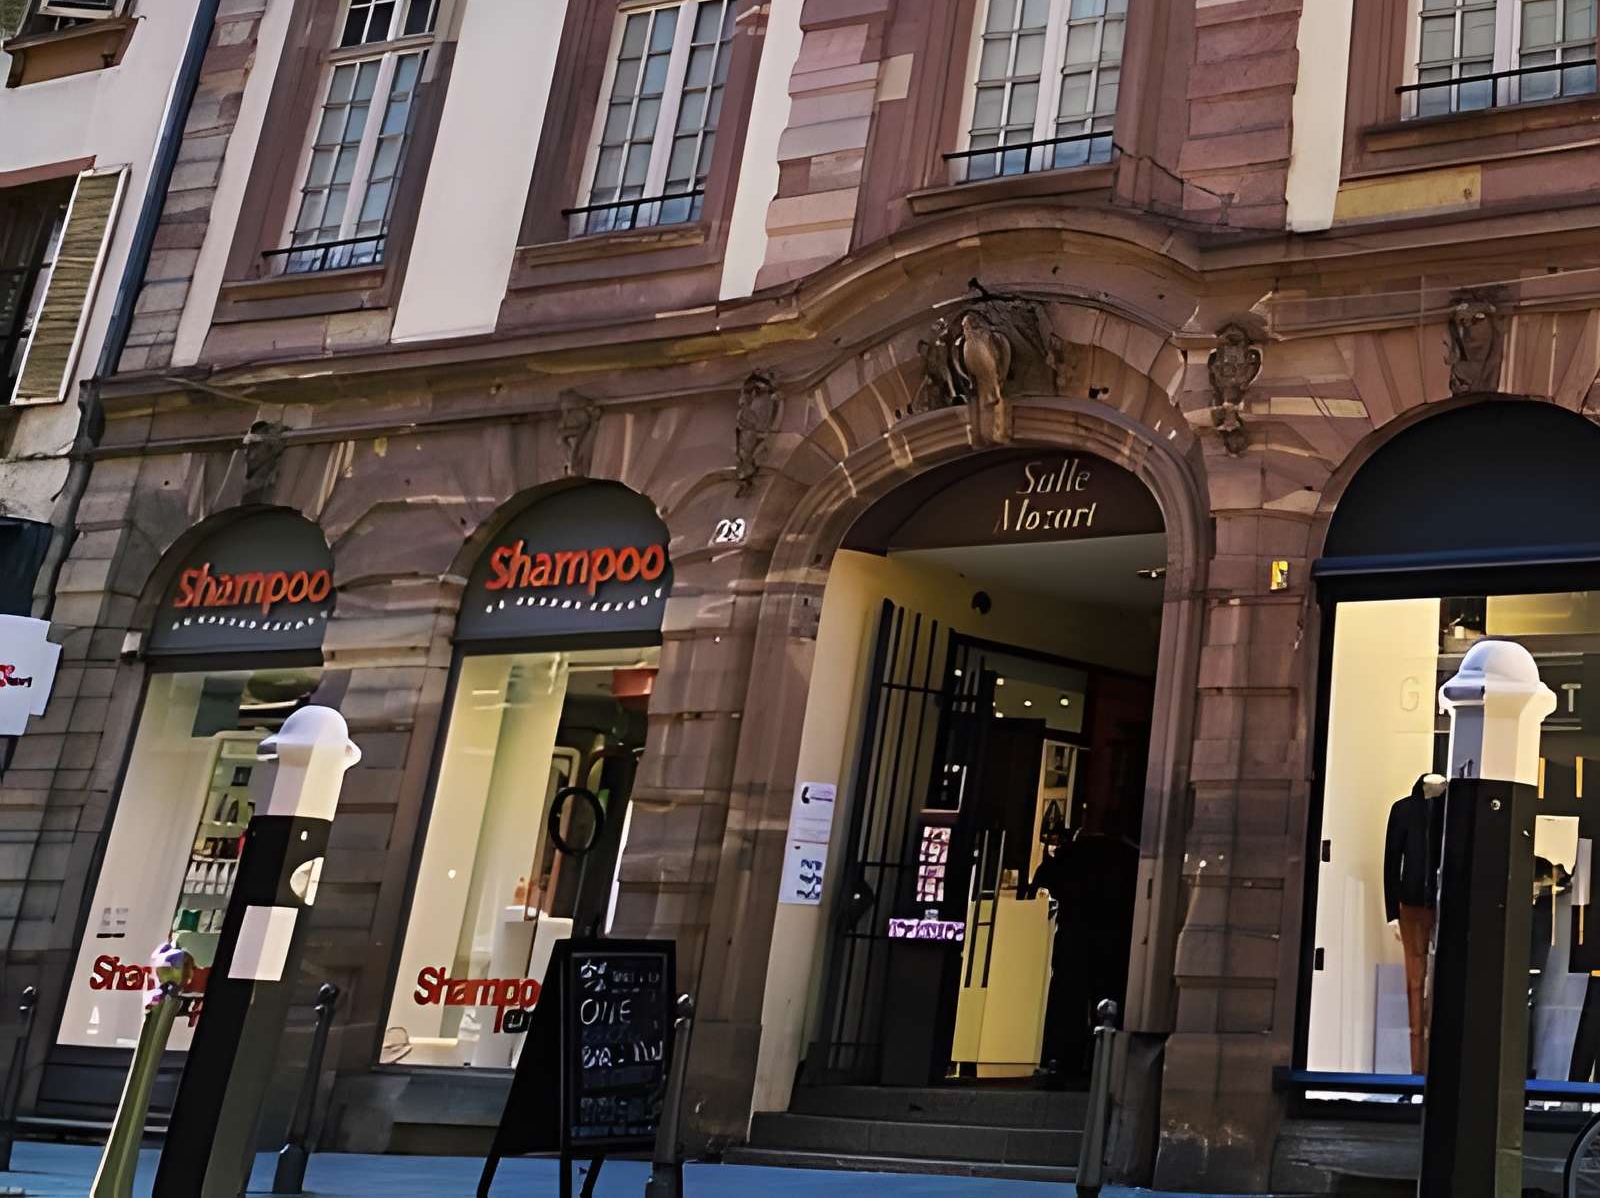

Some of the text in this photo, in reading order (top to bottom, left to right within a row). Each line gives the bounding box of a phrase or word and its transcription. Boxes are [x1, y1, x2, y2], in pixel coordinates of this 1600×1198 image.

[714, 518, 746, 543] 29
[172, 562, 331, 616] Shampoo
[485, 540, 665, 596] Shampoo
